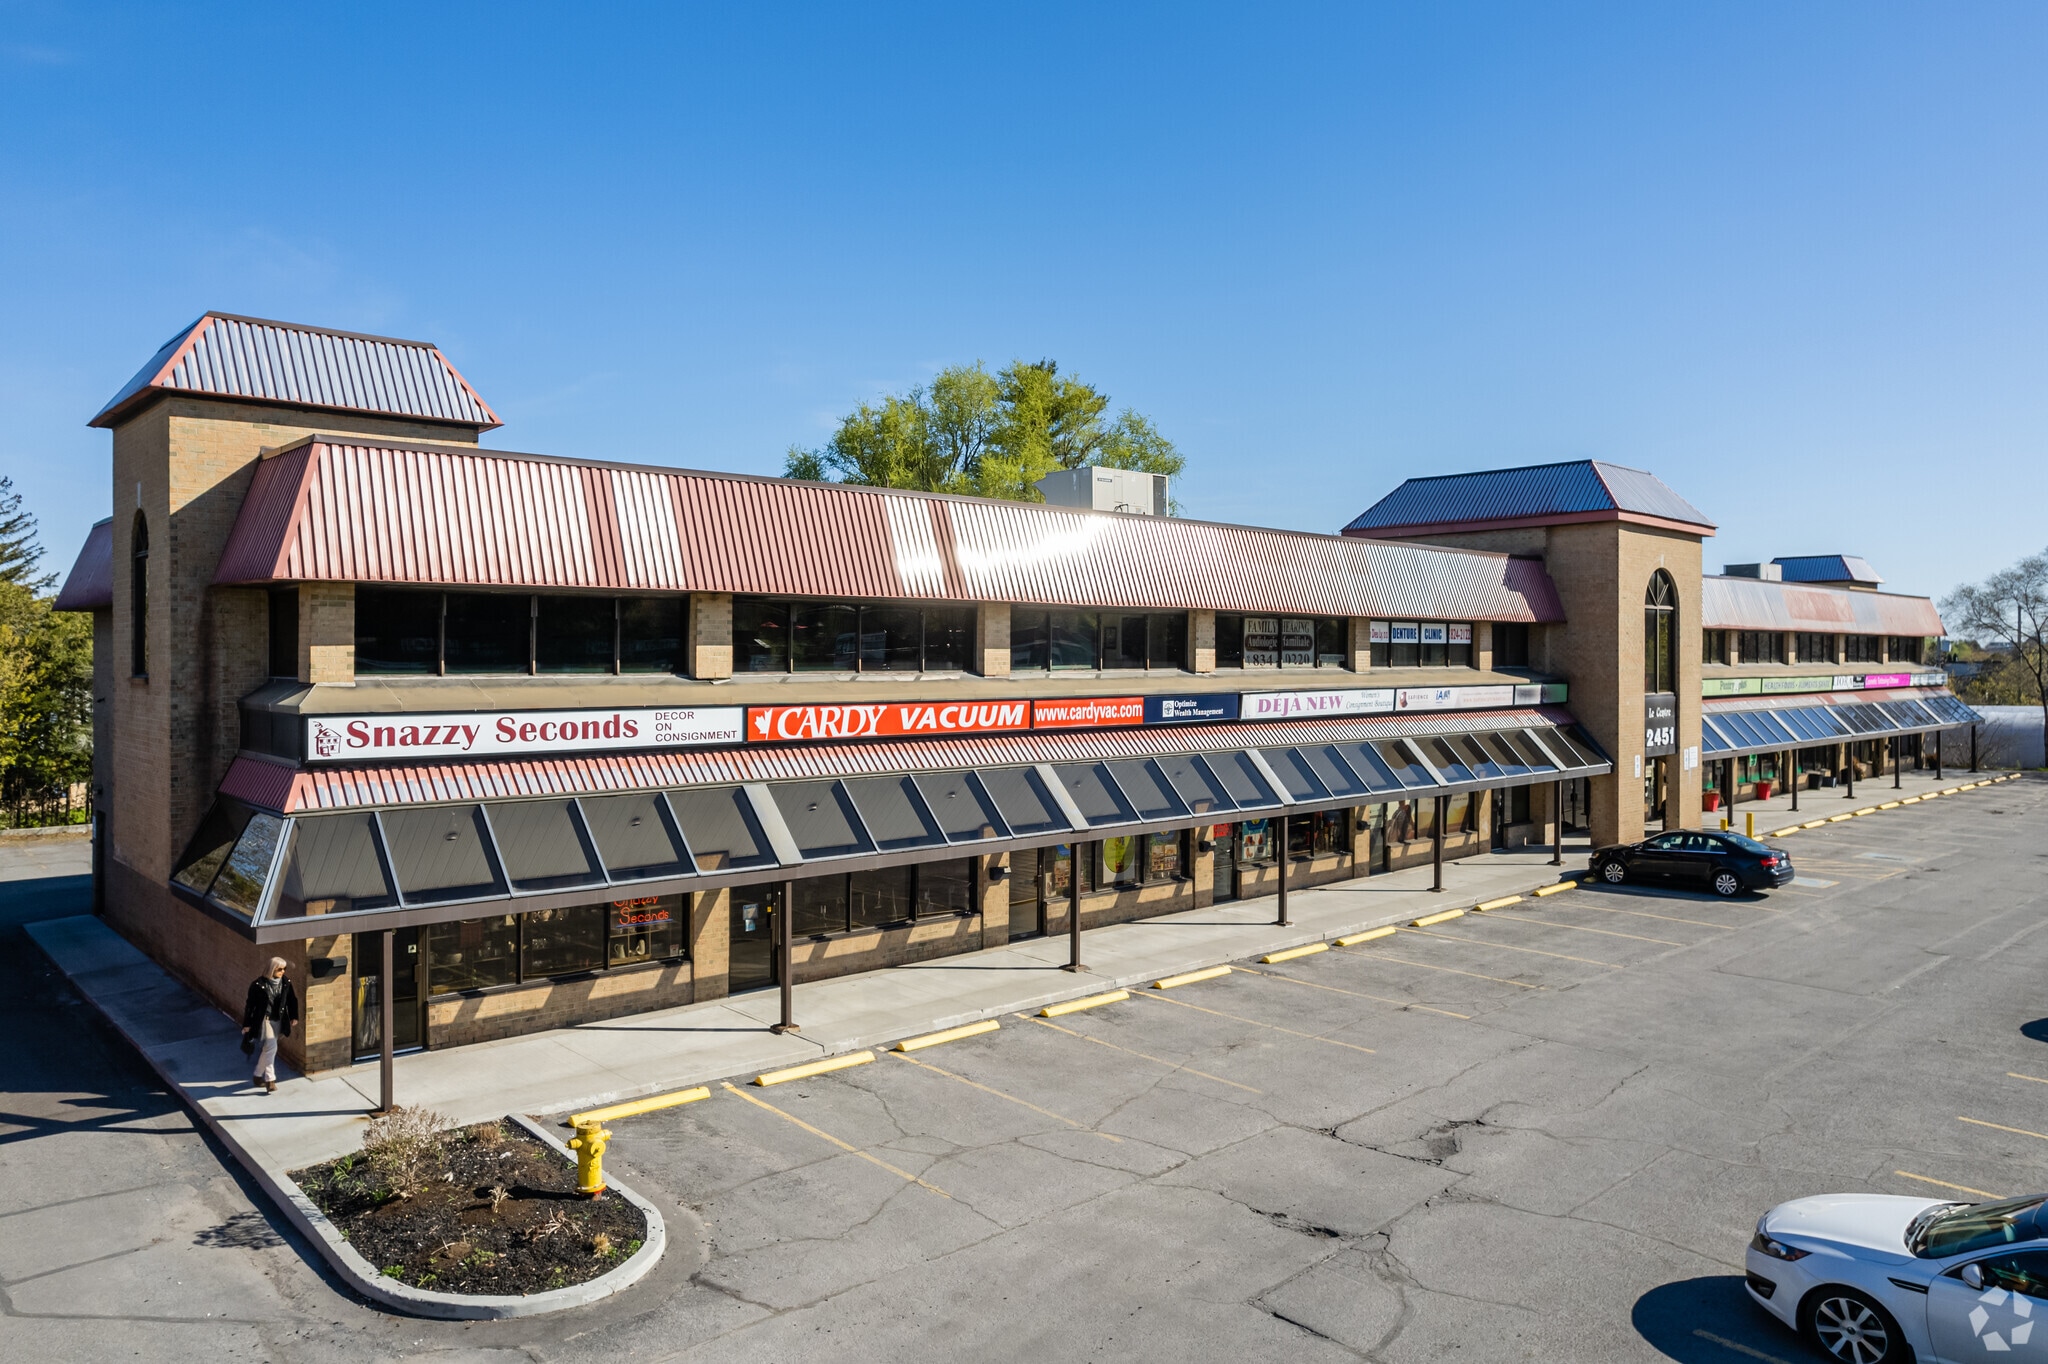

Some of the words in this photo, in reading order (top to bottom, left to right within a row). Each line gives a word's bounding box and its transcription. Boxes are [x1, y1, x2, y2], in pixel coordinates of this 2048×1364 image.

[1392, 627, 1417, 640] DENTURE
[1424, 628, 1442, 640] CLINIC
[1174, 700, 1197, 709] Optimize
[1258, 692, 1302, 717] DÉJÀ
[1306, 695, 1344, 711] NEW
[655, 711, 695, 721] DECOR
[1034, 703, 1143, 724] www.cardyvac.com
[1174, 709, 1192, 717] Wealth
[1192, 708, 1224, 717] Management
[1648, 707, 1655, 718] Le
[1656, 706, 1672, 718] Centre
[655, 722, 672, 731] ON
[777, 705, 887, 738] CARDY
[901, 704, 1025, 730] VACUUM
[346, 720, 480, 751] Snazzy
[495, 714, 639, 744] Seconds
[655, 730, 738, 742] CONSIGNMENT
[1646, 726, 1675, 747] 2451
[619, 907, 669, 925] Seconds
